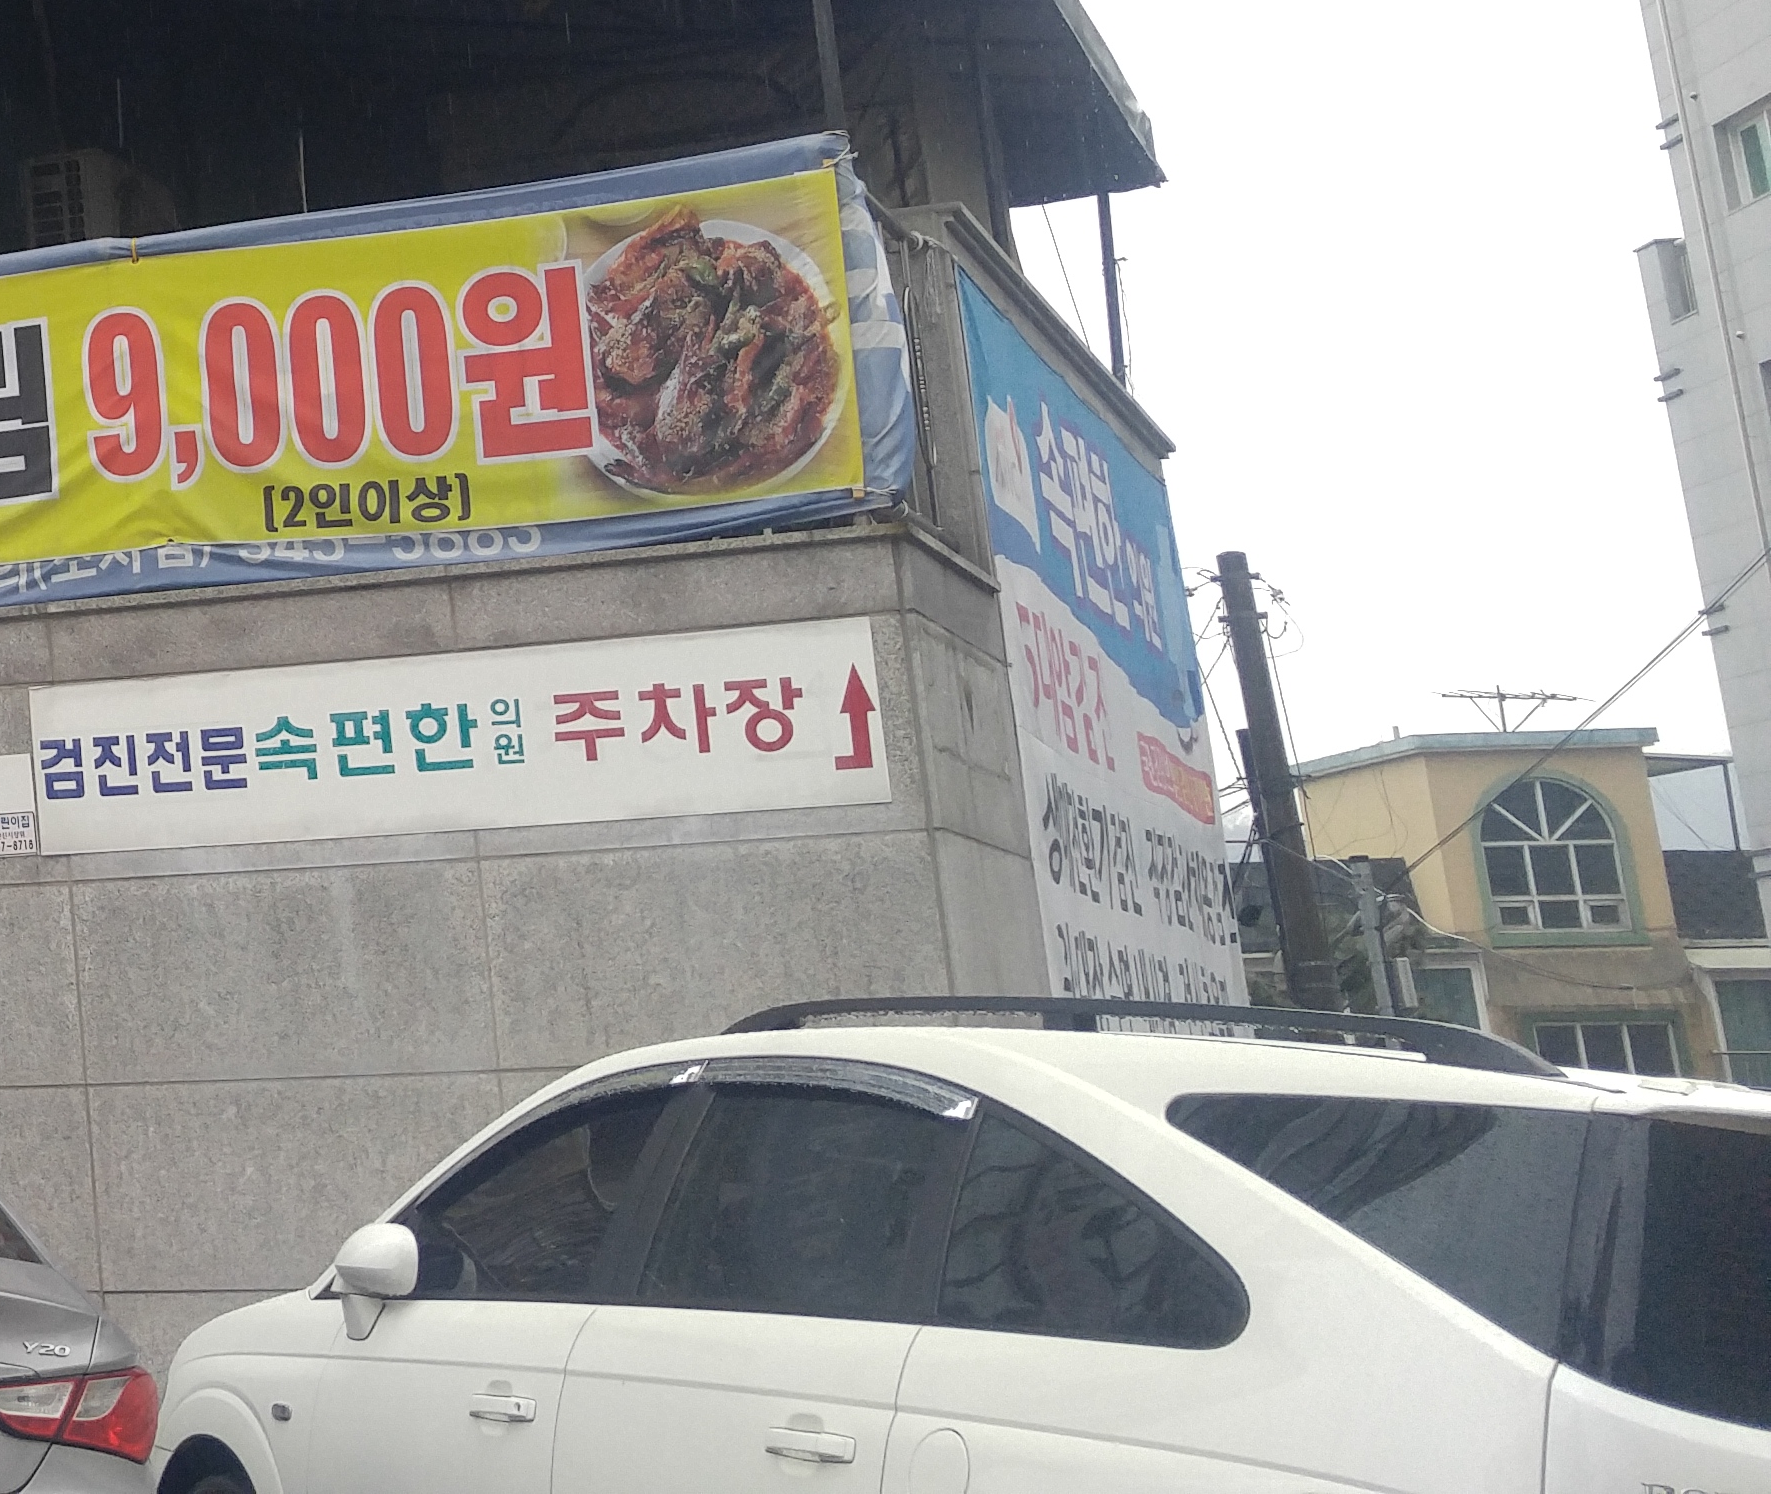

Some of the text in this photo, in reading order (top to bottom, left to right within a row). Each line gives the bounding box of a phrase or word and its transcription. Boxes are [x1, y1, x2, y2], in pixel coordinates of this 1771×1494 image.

[82, 260, 596, 487] 9,000원
[39, 675, 803, 801] 검진전문 속편한 의원 주차장
[21, 1340, 73, 1359] Y20
